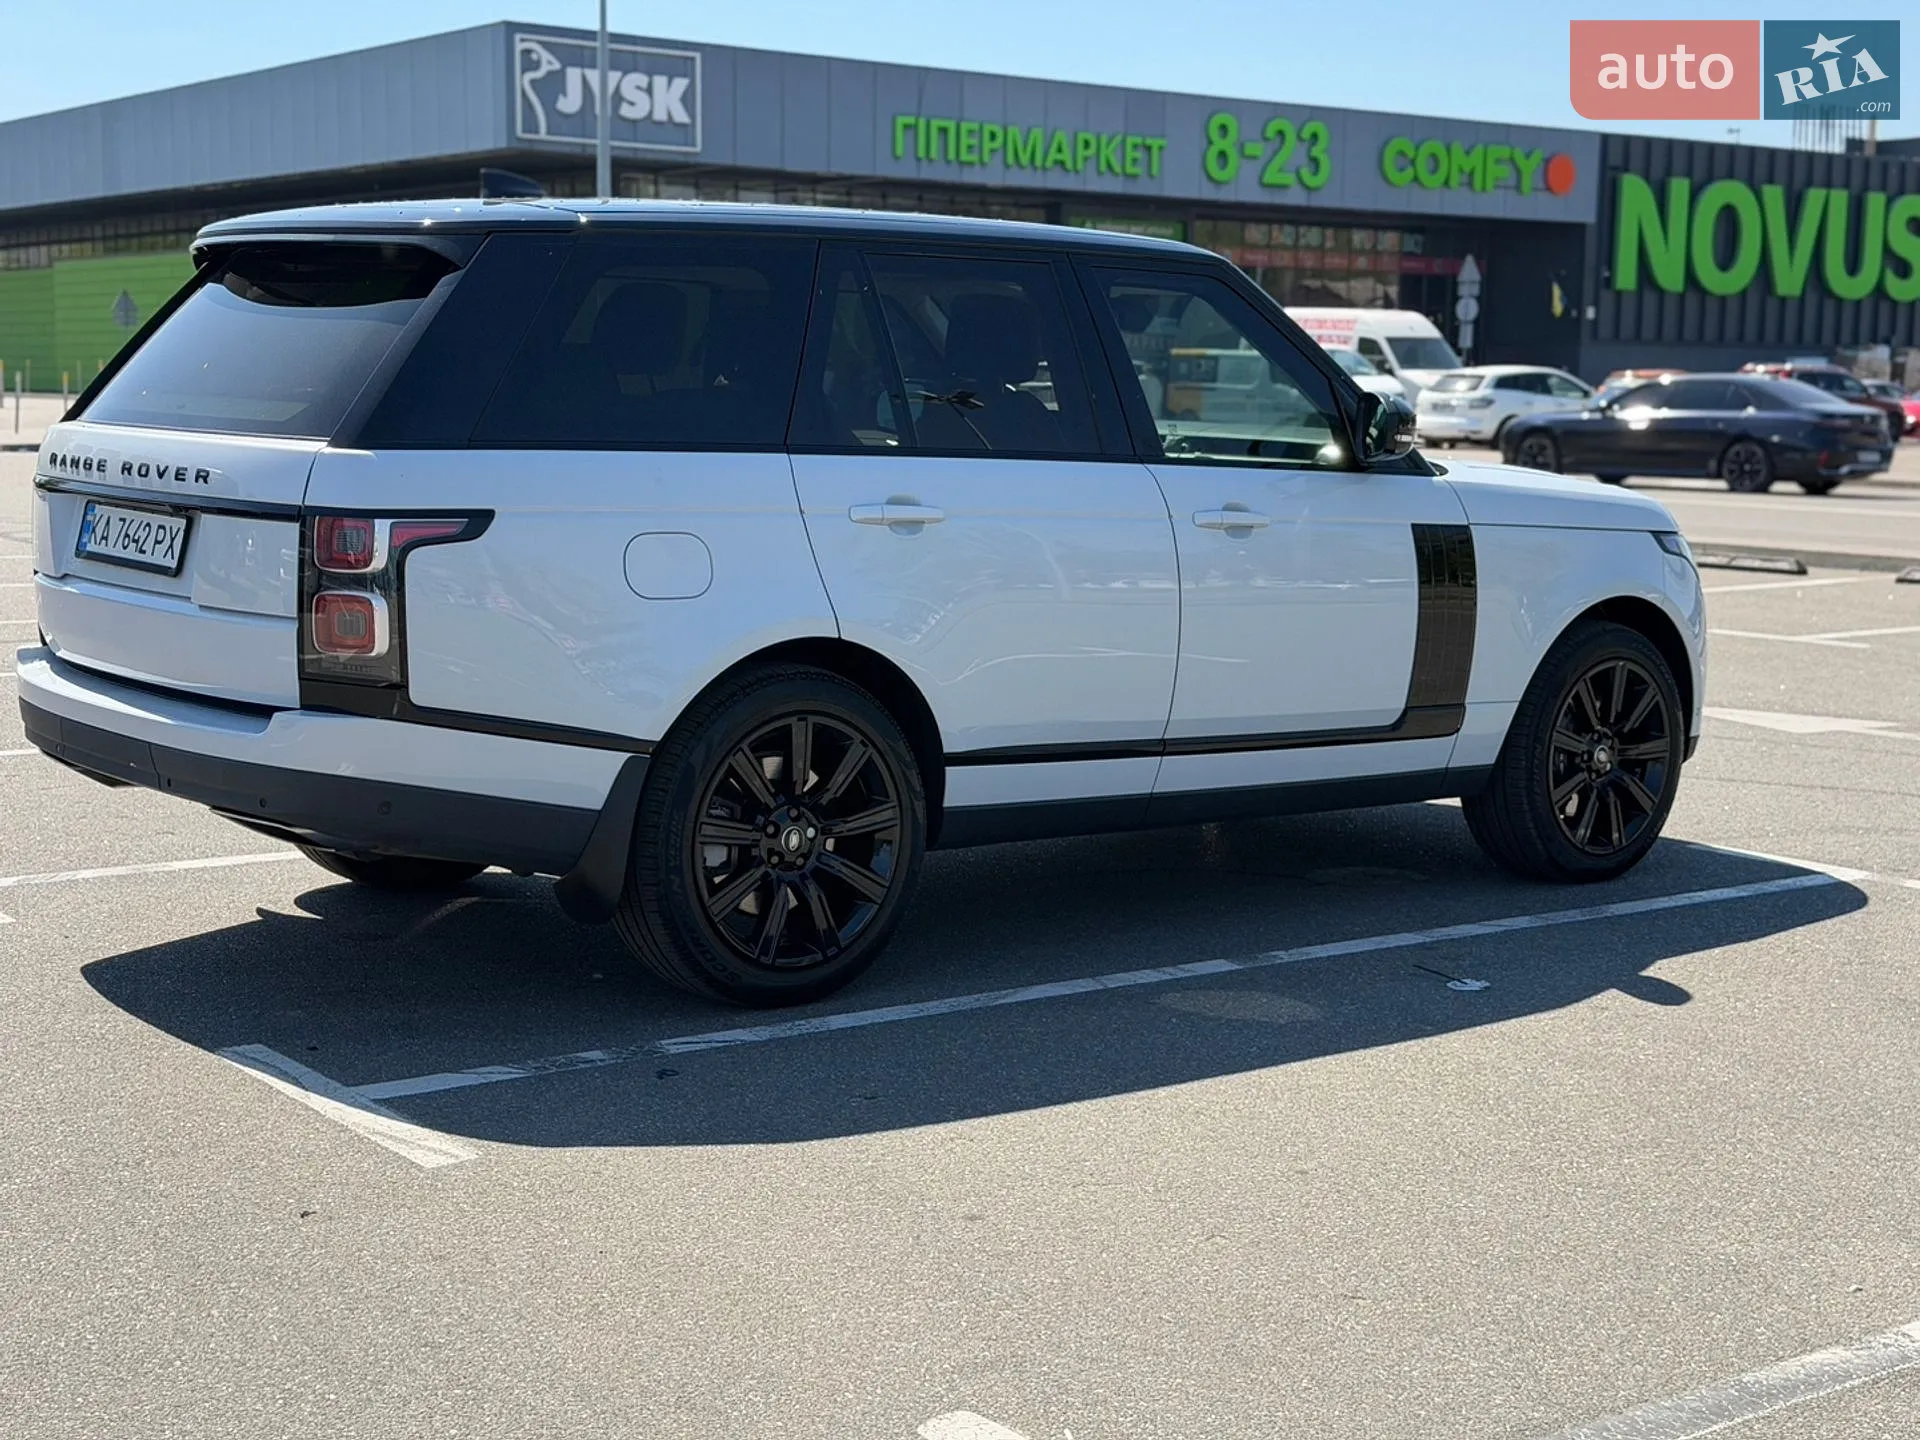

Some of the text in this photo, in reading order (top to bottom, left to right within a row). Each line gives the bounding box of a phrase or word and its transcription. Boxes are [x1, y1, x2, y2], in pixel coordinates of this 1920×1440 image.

[555, 66, 692, 124] JYSK
[893, 112, 1331, 190] ГІПЕРМАРКЕТ 8-23
[1381, 136, 1544, 195] COMFY
[1613, 172, 1920, 303] NOVUS
[49, 452, 211, 485] RANGE ROVER
